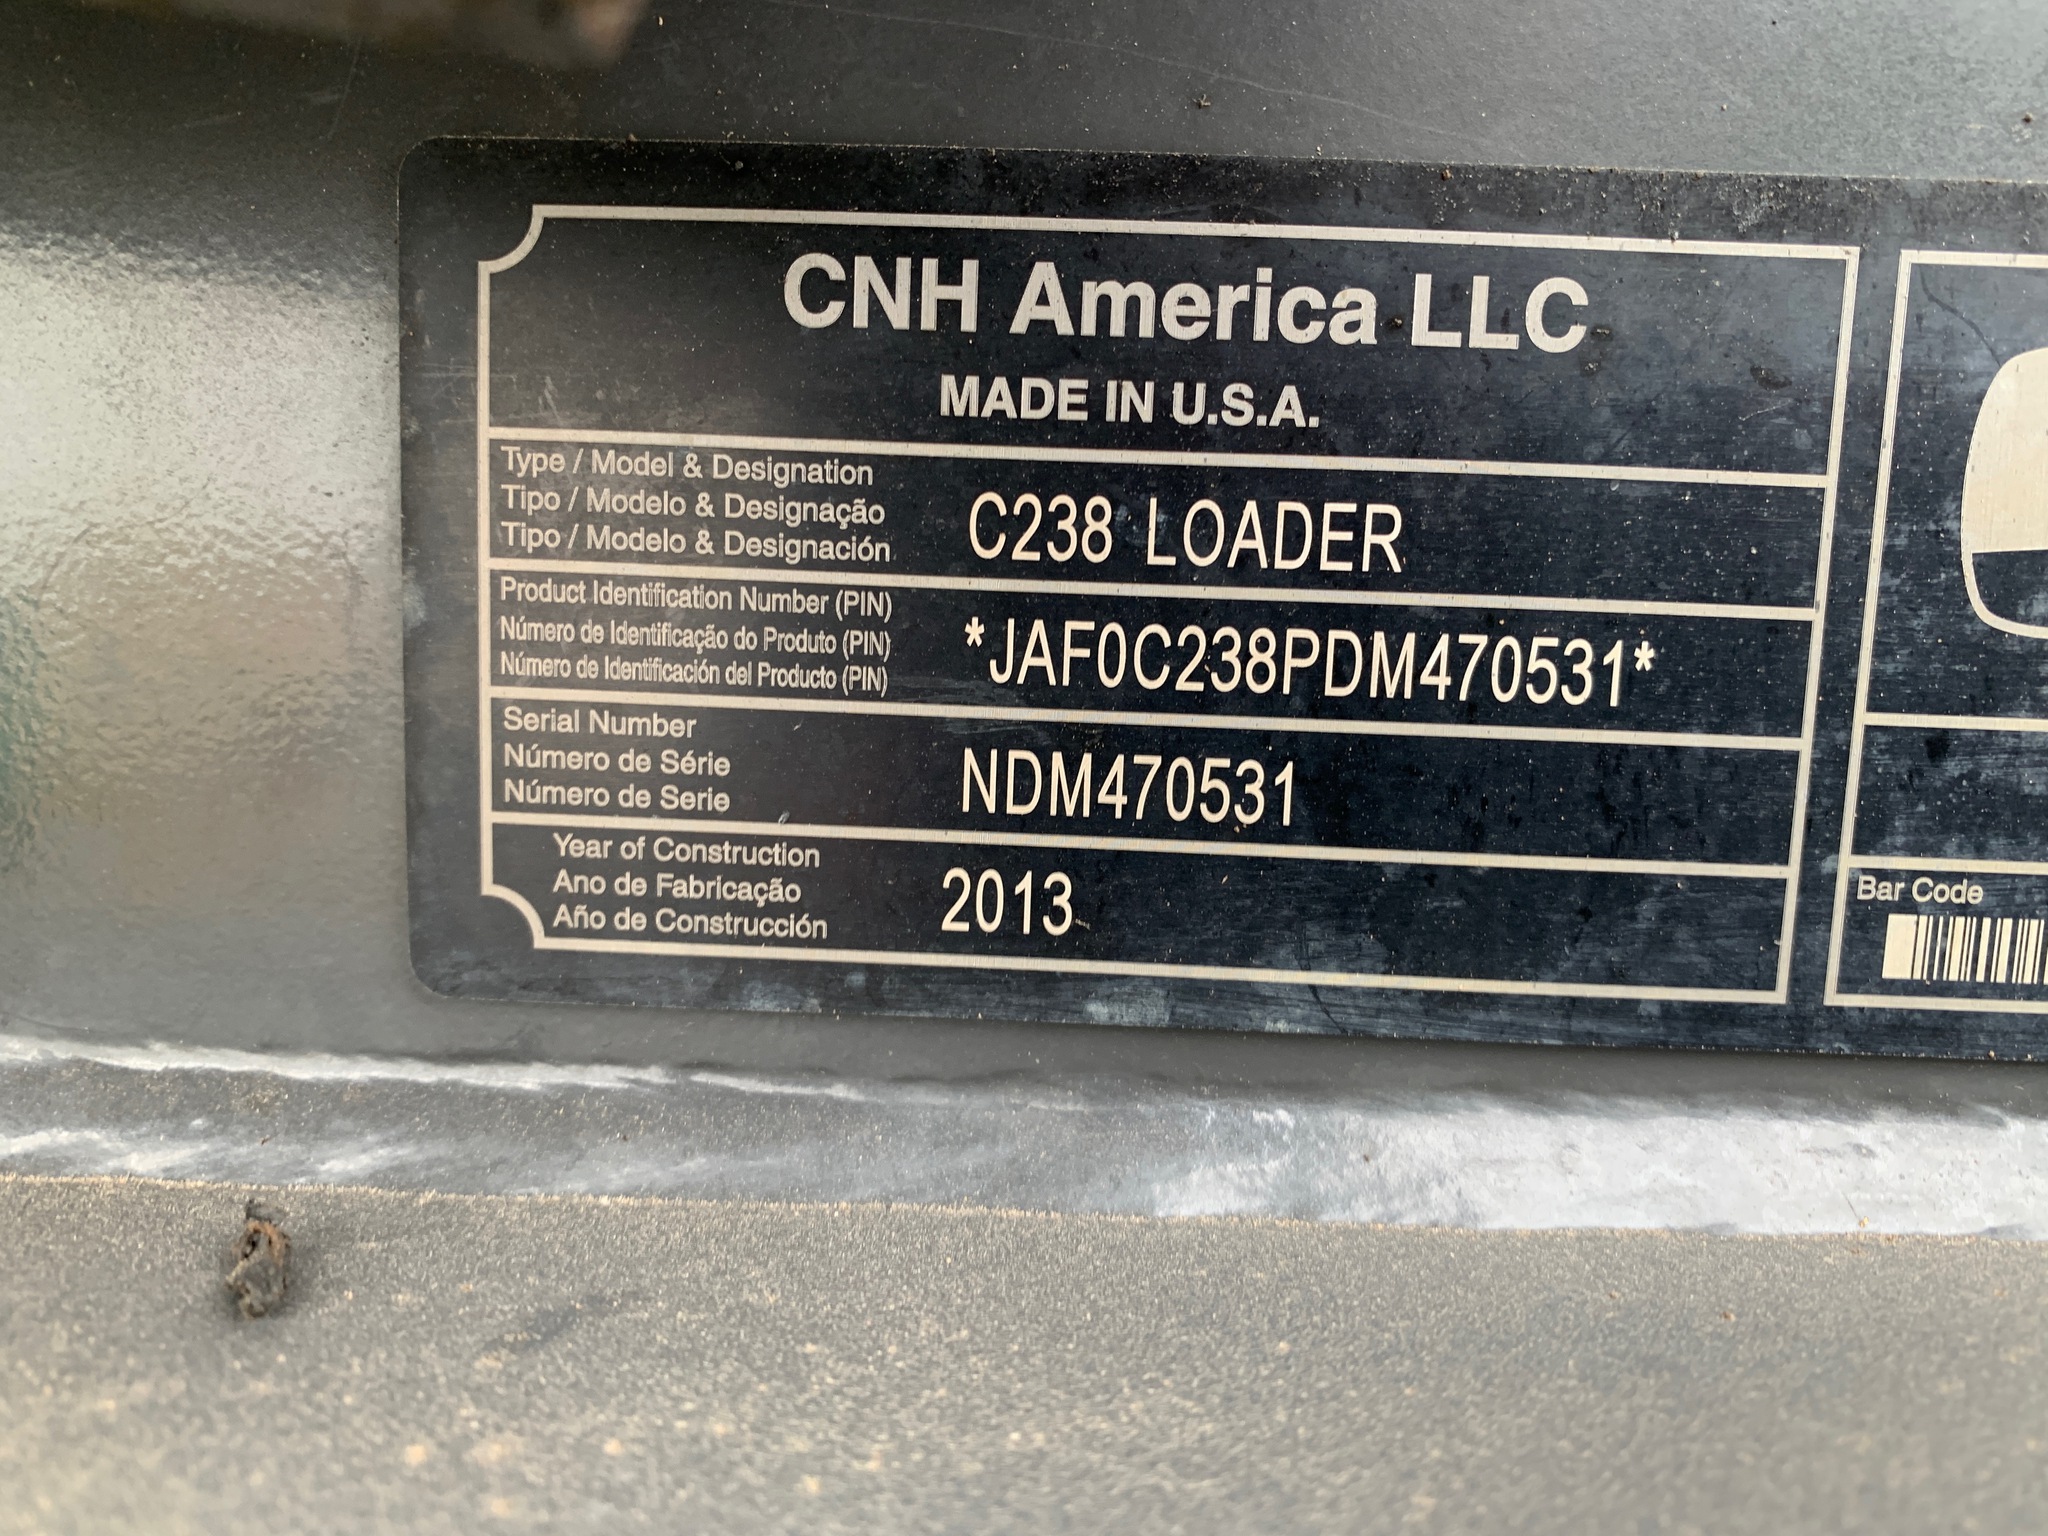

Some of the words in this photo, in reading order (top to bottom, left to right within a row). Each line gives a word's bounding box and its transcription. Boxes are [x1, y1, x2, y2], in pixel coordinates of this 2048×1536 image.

[783, 252, 979, 331] CNH
[1009, 261, 1377, 345] America
[1412, 273, 1590, 353] LLC
[939, 373, 1089, 422] MADE
[1105, 380, 1153, 423] IN
[1172, 383, 1320, 428] U.S.A.
[501, 446, 565, 476] Type
[573, 449, 583, 473] /
[591, 449, 673, 477] Model
[683, 453, 702, 479] &
[713, 453, 873, 488] Designation
[501, 485, 561, 515] Tipo
[568, 486, 579, 512] /
[587, 487, 686, 516] Modelo
[695, 492, 715, 518] &
[725, 493, 885, 529] Designação
[501, 522, 561, 552] Tipo
[568, 523, 579, 549] /
[587, 524, 686, 553] Modelo
[695, 529, 715, 555] &
[725, 530, 891, 565] Designación
[969, 492, 1113, 562] C238
[1148, 498, 1402, 572] LOADER
[501, 577, 586, 604] Product
[593, 581, 732, 611] Identification
[740, 586, 829, 614] Number
[835, 590, 892, 623] (PIN)
[501, 616, 575, 643] Número
[581, 620, 603, 644] de
[611, 622, 728, 654] Identificação
[734, 626, 757, 650] do
[764, 627, 837, 655] Produto
[842, 629, 891, 661] (PIN)
[501, 652, 571, 678] Número
[577, 655, 598, 679] de
[605, 656, 720, 685] Identificación
[726, 660, 752, 686] del
[758, 661, 837, 690] Producto
[842, 665, 888, 697] (PIN)
[504, 706, 579, 734] Serial
[590, 711, 696, 738] Number
[504, 743, 610, 772] Número
[618, 749, 652, 773] de
[661, 749, 730, 776] Série
[504, 779, 610, 808] Número
[618, 784, 652, 809] de
[661, 785, 730, 812] Serie
[962, 748, 1293, 826] NDM470531
[553, 833, 612, 859] Year
[620, 836, 645, 860] of
[653, 837, 820, 868] Construction
[553, 869, 605, 895] Ano
[614, 871, 647, 896] de
[656, 874, 801, 907] Fabricação
[941, 867, 1073, 936] 2013
[1857, 875, 1905, 901] Bar
[1911, 877, 1983, 904] Code
[553, 904, 605, 929] Año
[614, 907, 647, 931] de
[655, 908, 827, 939] Construcción
